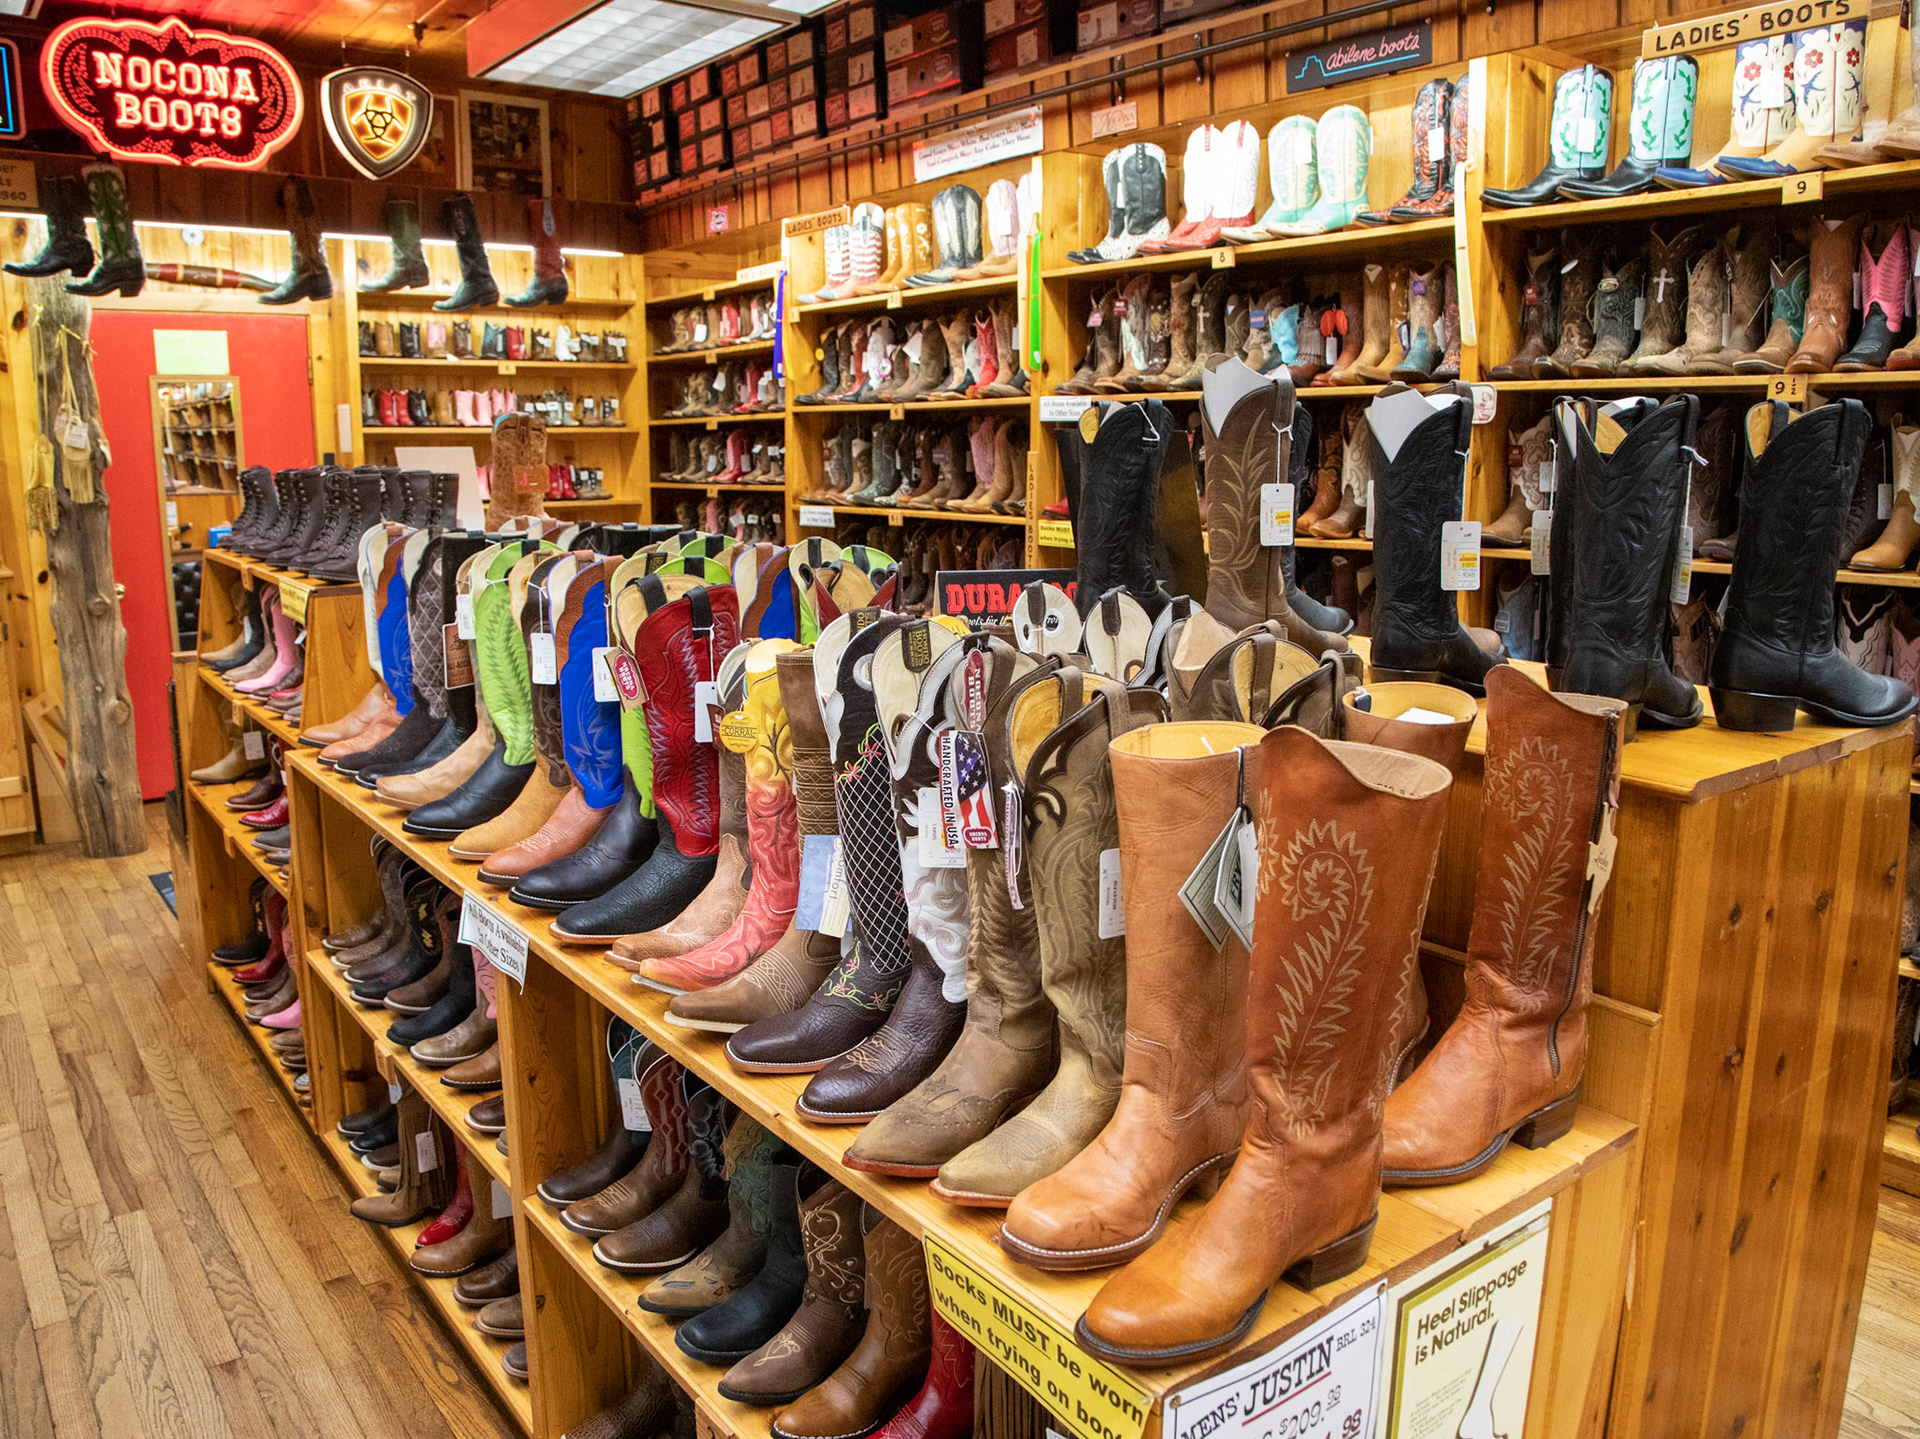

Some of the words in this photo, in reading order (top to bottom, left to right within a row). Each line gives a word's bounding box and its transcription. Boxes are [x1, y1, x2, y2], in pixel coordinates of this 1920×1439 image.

[1656, 14, 1749, 52] LADIES'
[1760, 0, 1851, 32] BOOTS
[1326, 43, 1377, 70] abilene
[1379, 32, 1420, 57] boots
[92, 50, 260, 105] NOCONA
[114, 92, 242, 137] BOOTS
[1797, 181, 1807, 194] 9
[817, 212, 843, 227] BOOTS
[1774, 381, 1786, 395] 9
[922, 629, 930, 665] HONDO
[619, 667, 631, 690] BOOTS
[622, 661, 635, 690] NOCONA
[968, 675, 976, 729] BOOTS
[974, 668, 982, 733] NOCONA
[724, 726, 755, 738] CORRAL
[941, 737, 954, 809] HANDCRAFTED
[945, 812, 956, 824] IN
[947, 826, 960, 846] USA
[829, 856, 846, 900] omfort
[479, 909, 495, 933] Boots
[495, 923, 526, 957] Available
[500, 948, 520, 973] Sizes
[1416, 1298, 1456, 1340] Heel
[1458, 1259, 1528, 1315] Slippage
[932, 1253, 987, 1306] Socks
[992, 1296, 1051, 1352] MUST
[1056, 1344, 1082, 1379] be
[1088, 1373, 1144, 1428] worn
[935, 1287, 982, 1335] when
[986, 1327, 1041, 1387] trying
[1047, 1379, 1070, 1410] on
[1414, 1344, 1428, 1367] is
[1431, 1300, 1495, 1357] Natural.
[1243, 1335, 1335, 1416] JUSTIN
[1335, 1329, 1357, 1353] BRL
[1359, 1316, 1377, 1336] 324
